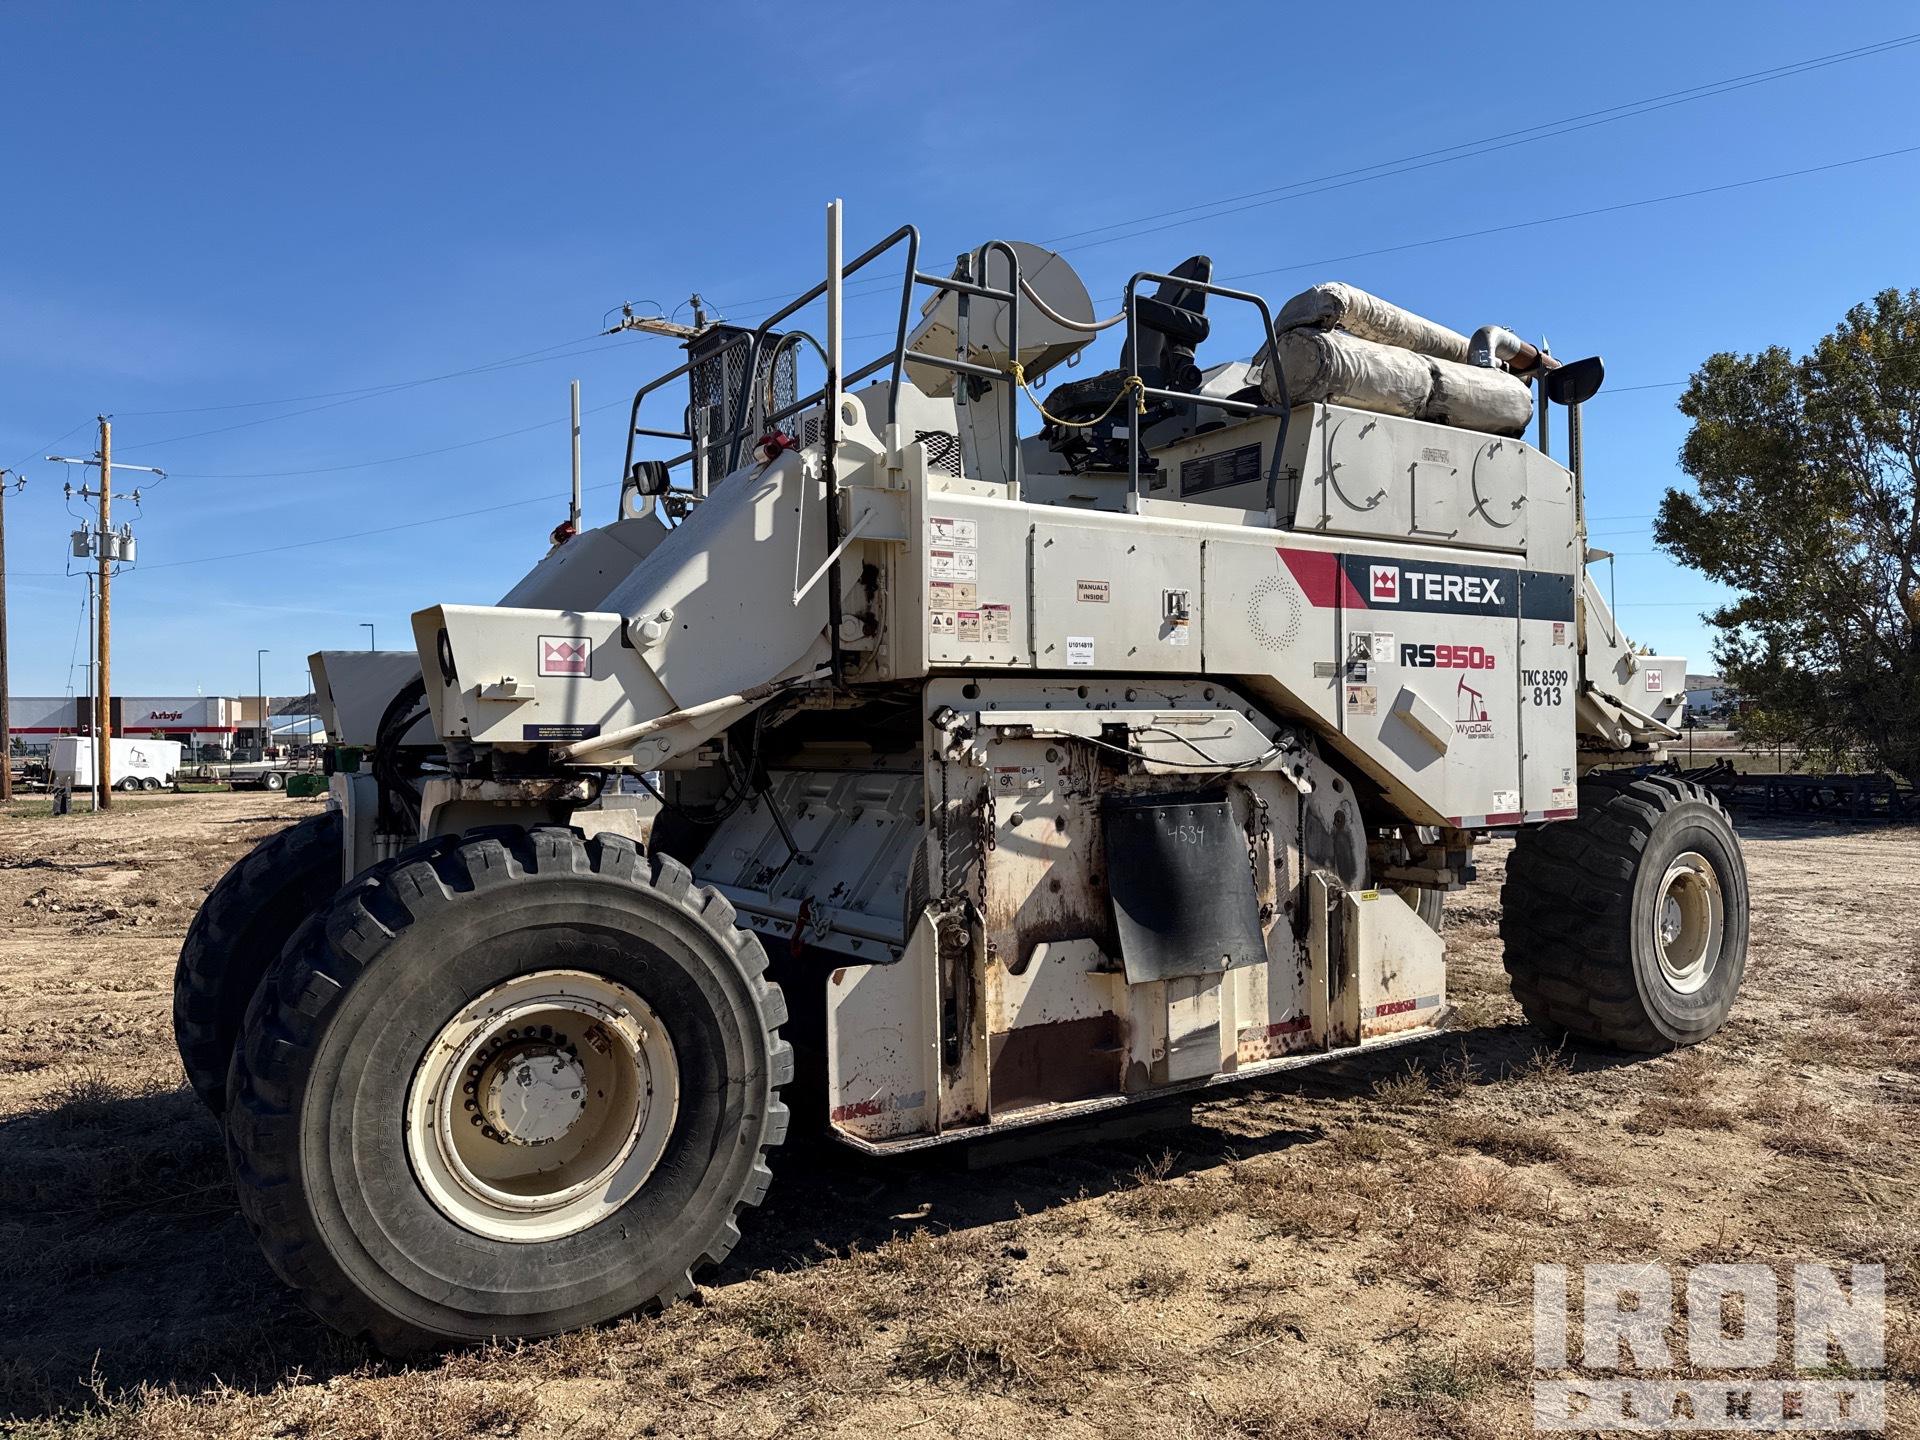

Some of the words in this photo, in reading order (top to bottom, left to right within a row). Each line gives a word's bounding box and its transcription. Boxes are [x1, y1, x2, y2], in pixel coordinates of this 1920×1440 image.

[1405, 572, 1500, 604] TEREX
[1401, 643, 1495, 669] RS950B
[1521, 669, 1541, 686] TKC
[1542, 670, 1568, 686] 8599
[1533, 687, 1562, 706] 813
[150, 710, 183, 721] Arby's
[1167, 825, 1204, 847] 4534
[667, 1129, 699, 1186] RADIAL
